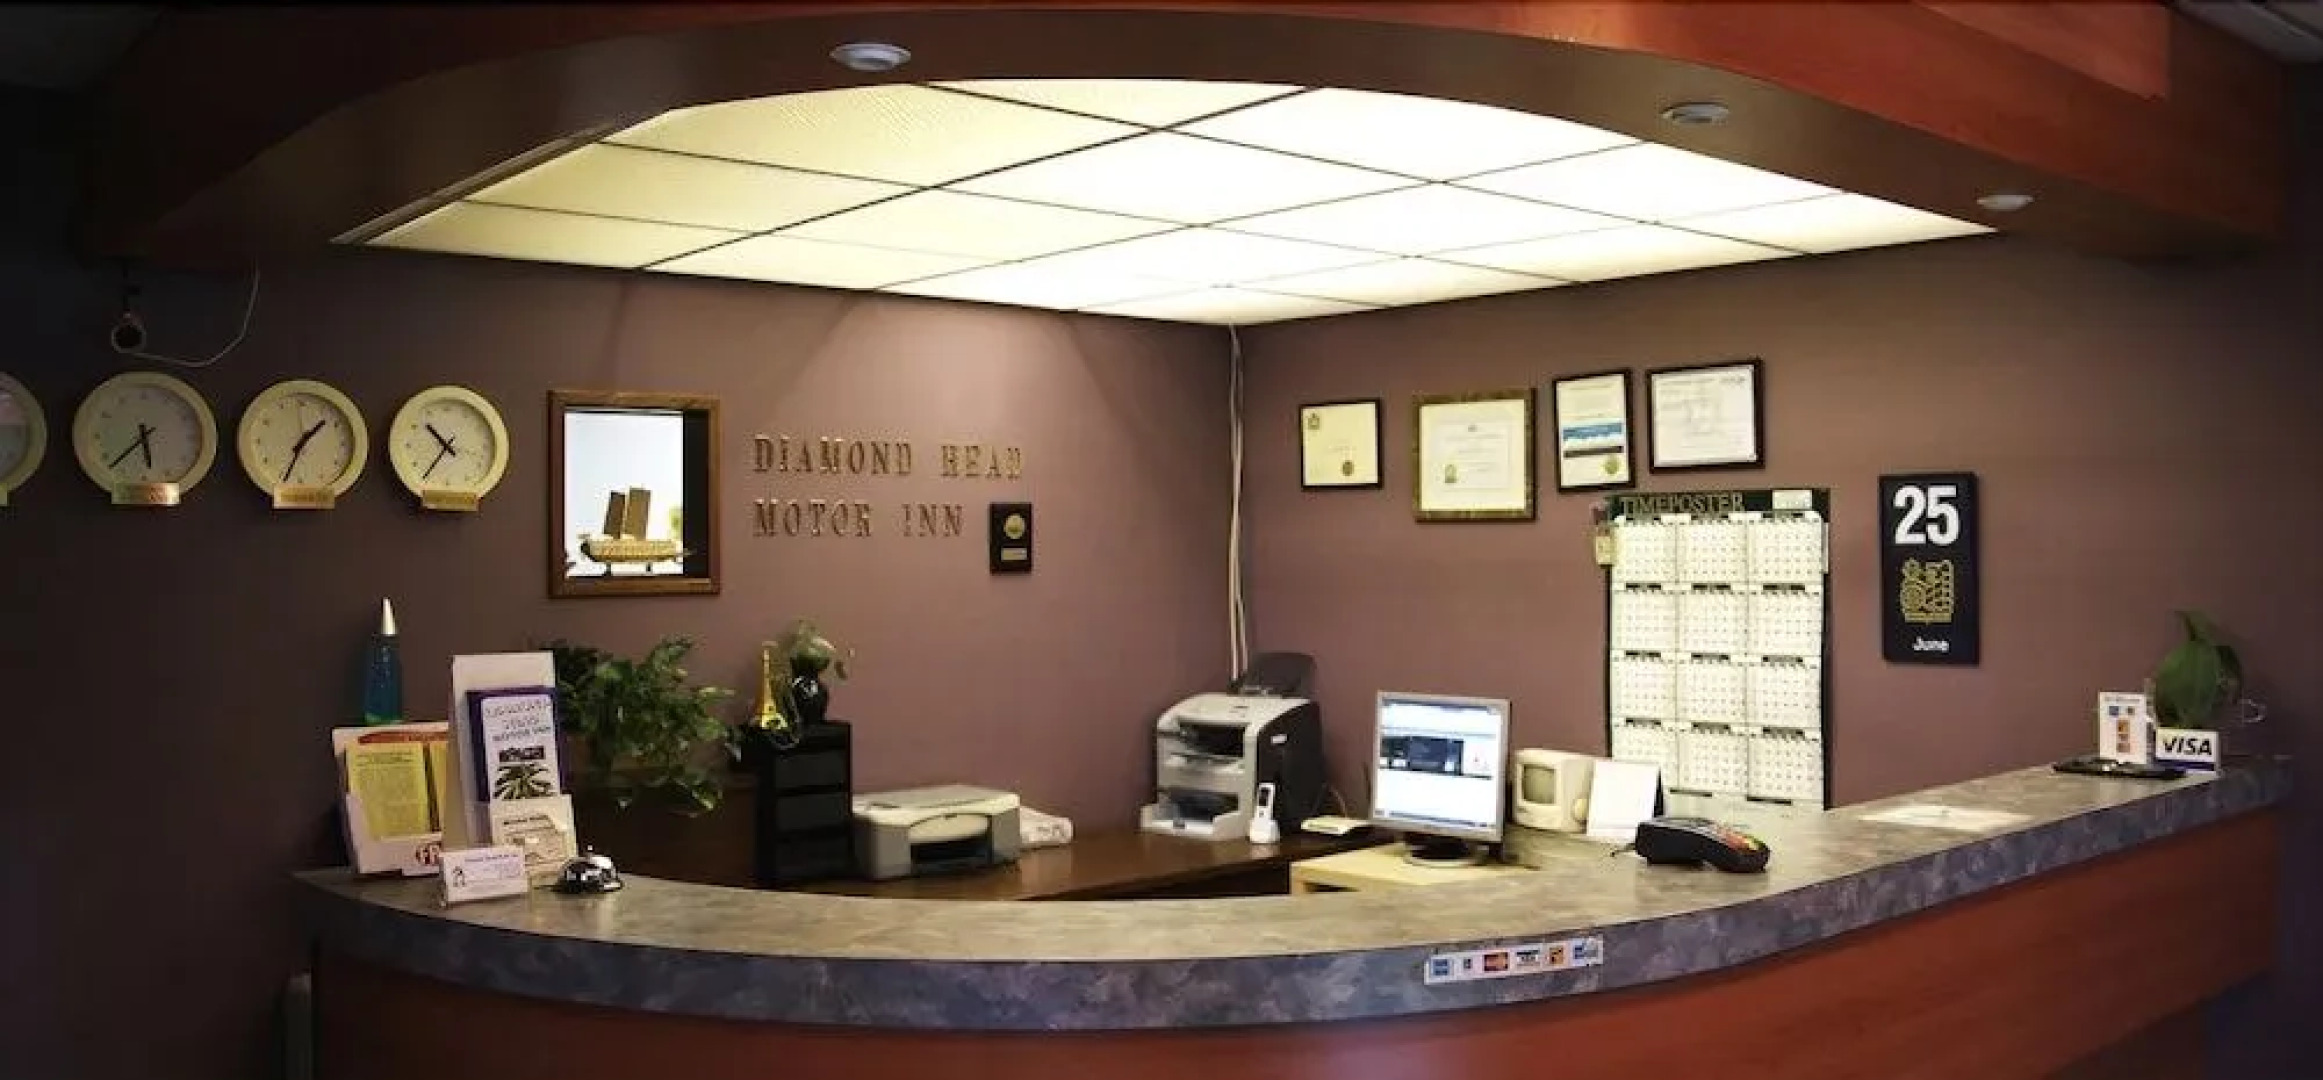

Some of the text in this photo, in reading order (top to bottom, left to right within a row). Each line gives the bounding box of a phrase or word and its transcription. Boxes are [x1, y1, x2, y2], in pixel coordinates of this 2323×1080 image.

[752, 434, 1022, 479] DIAMOND HEAD
[752, 499, 964, 537] MOTOR INN
[1619, 491, 1746, 515] TIMEPOSTER
[1893, 484, 1960, 546] 25
[1912, 636, 1950, 652] June
[2162, 737, 2213, 756] VISA
